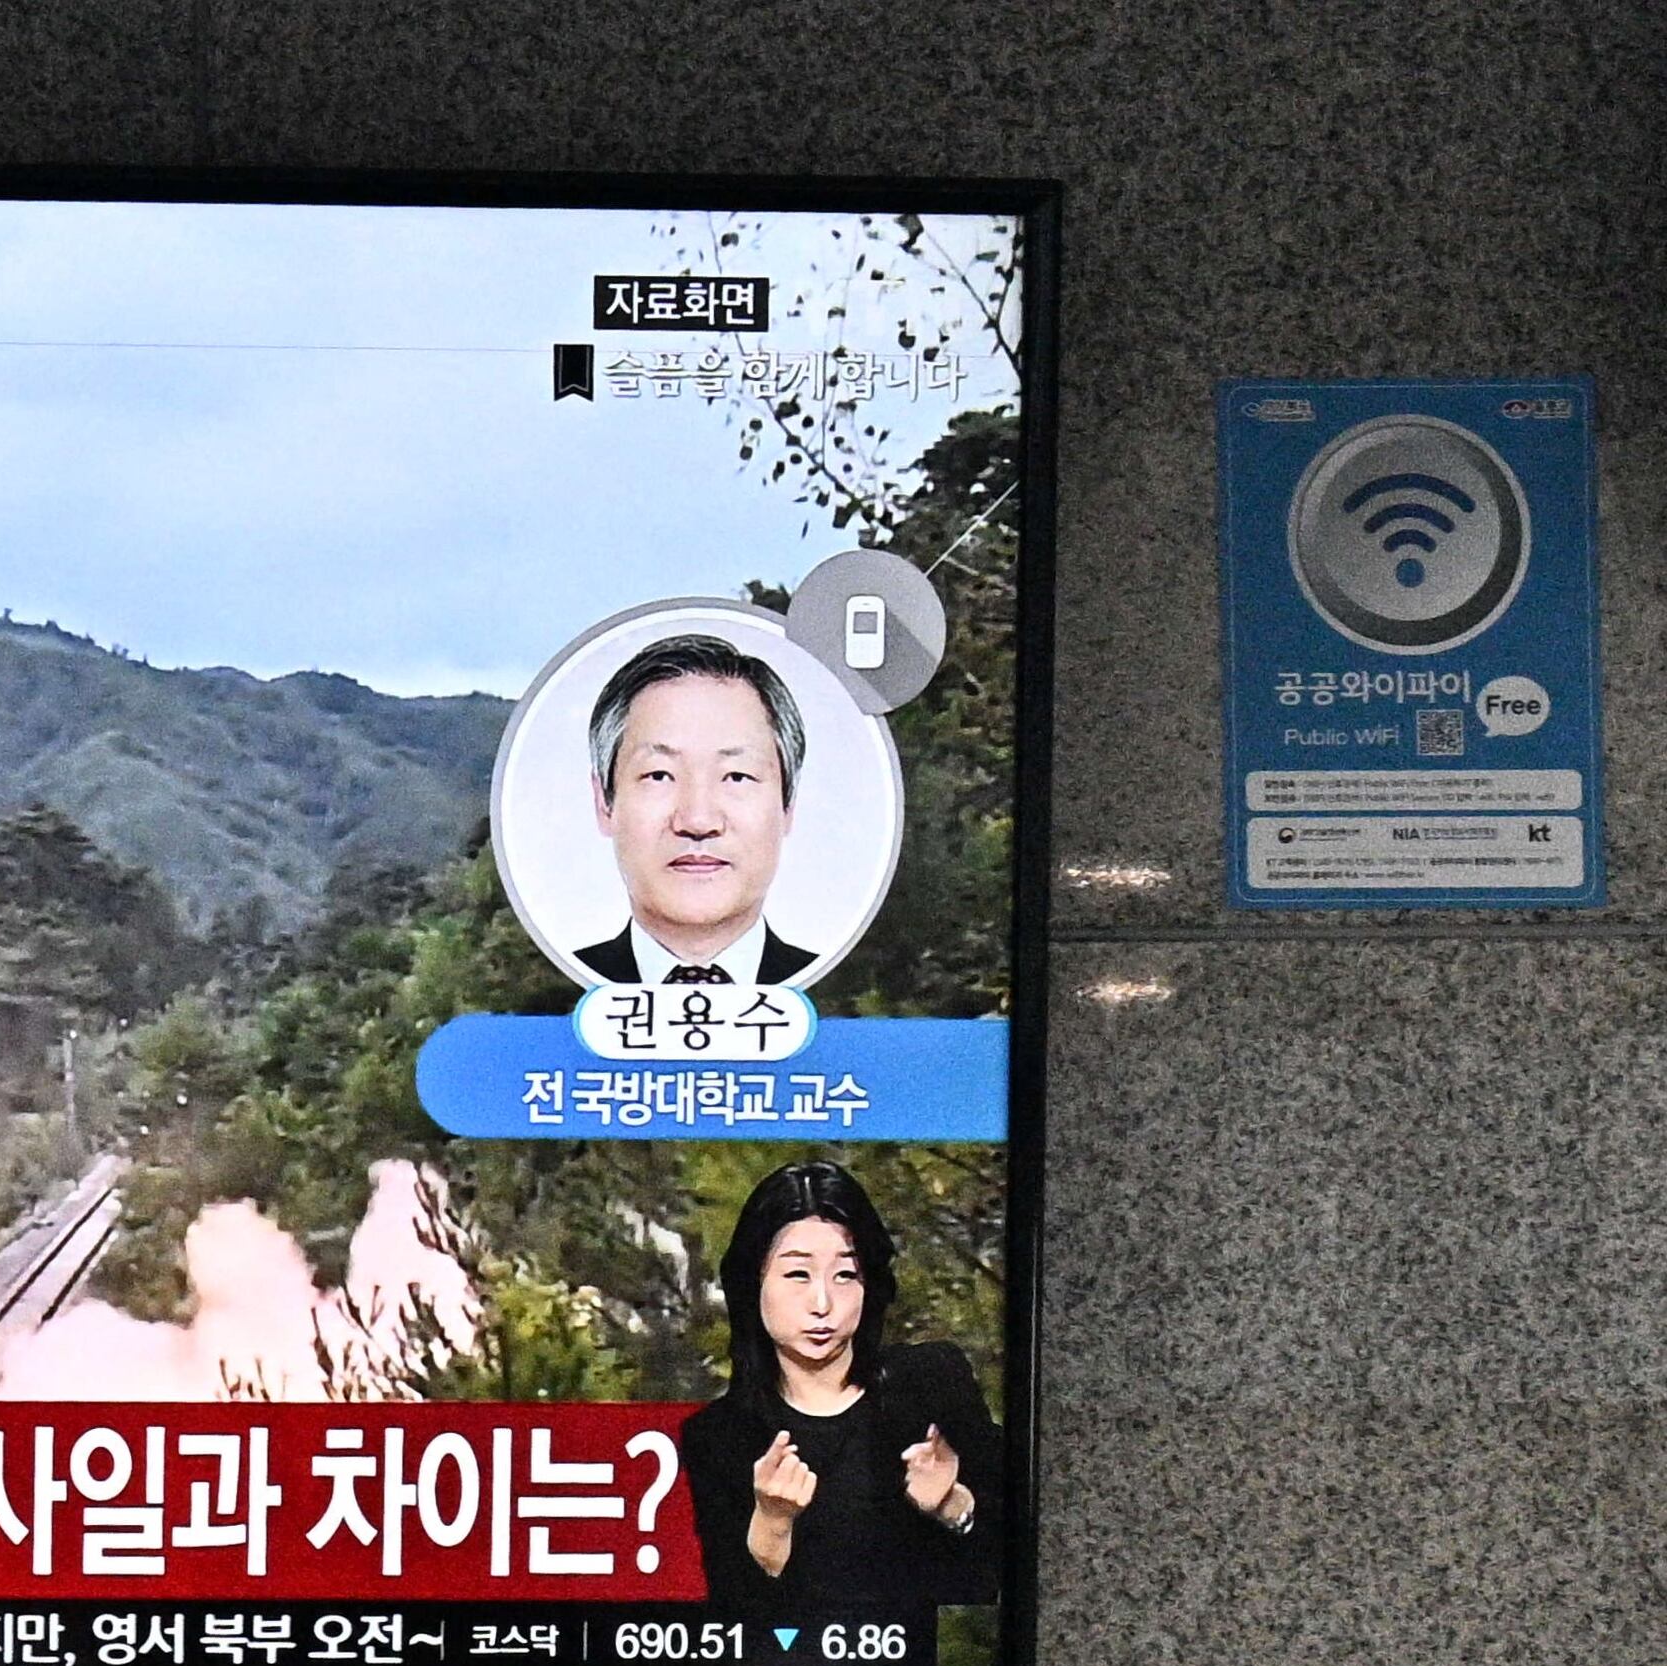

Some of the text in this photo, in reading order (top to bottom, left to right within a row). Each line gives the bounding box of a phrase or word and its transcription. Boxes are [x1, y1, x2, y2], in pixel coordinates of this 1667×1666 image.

[604, 280, 757, 326] 자료화면
[599, 346, 969, 402] 슬픔을 함께 합니다
[1274, 670, 1471, 706] 공공와이파이
[1484, 694, 1543, 717] Free
[1283, 728, 1349, 746] Public
[1391, 827, 1422, 841] NIA
[1528, 823, 1551, 843] kt
[606, 990, 791, 1053] 권용수
[521, 1070, 870, 1127] 전 국방대학교 교수
[305, 1427, 679, 1577] 차이는?
[92, 1613, 185, 1666] 영서
[199, 1613, 296, 1665] 북부
[469, 1624, 560, 1657] 코스닥
[615, 1622, 743, 1659] 690.51
[821, 1623, 907, 1660] 6.86
